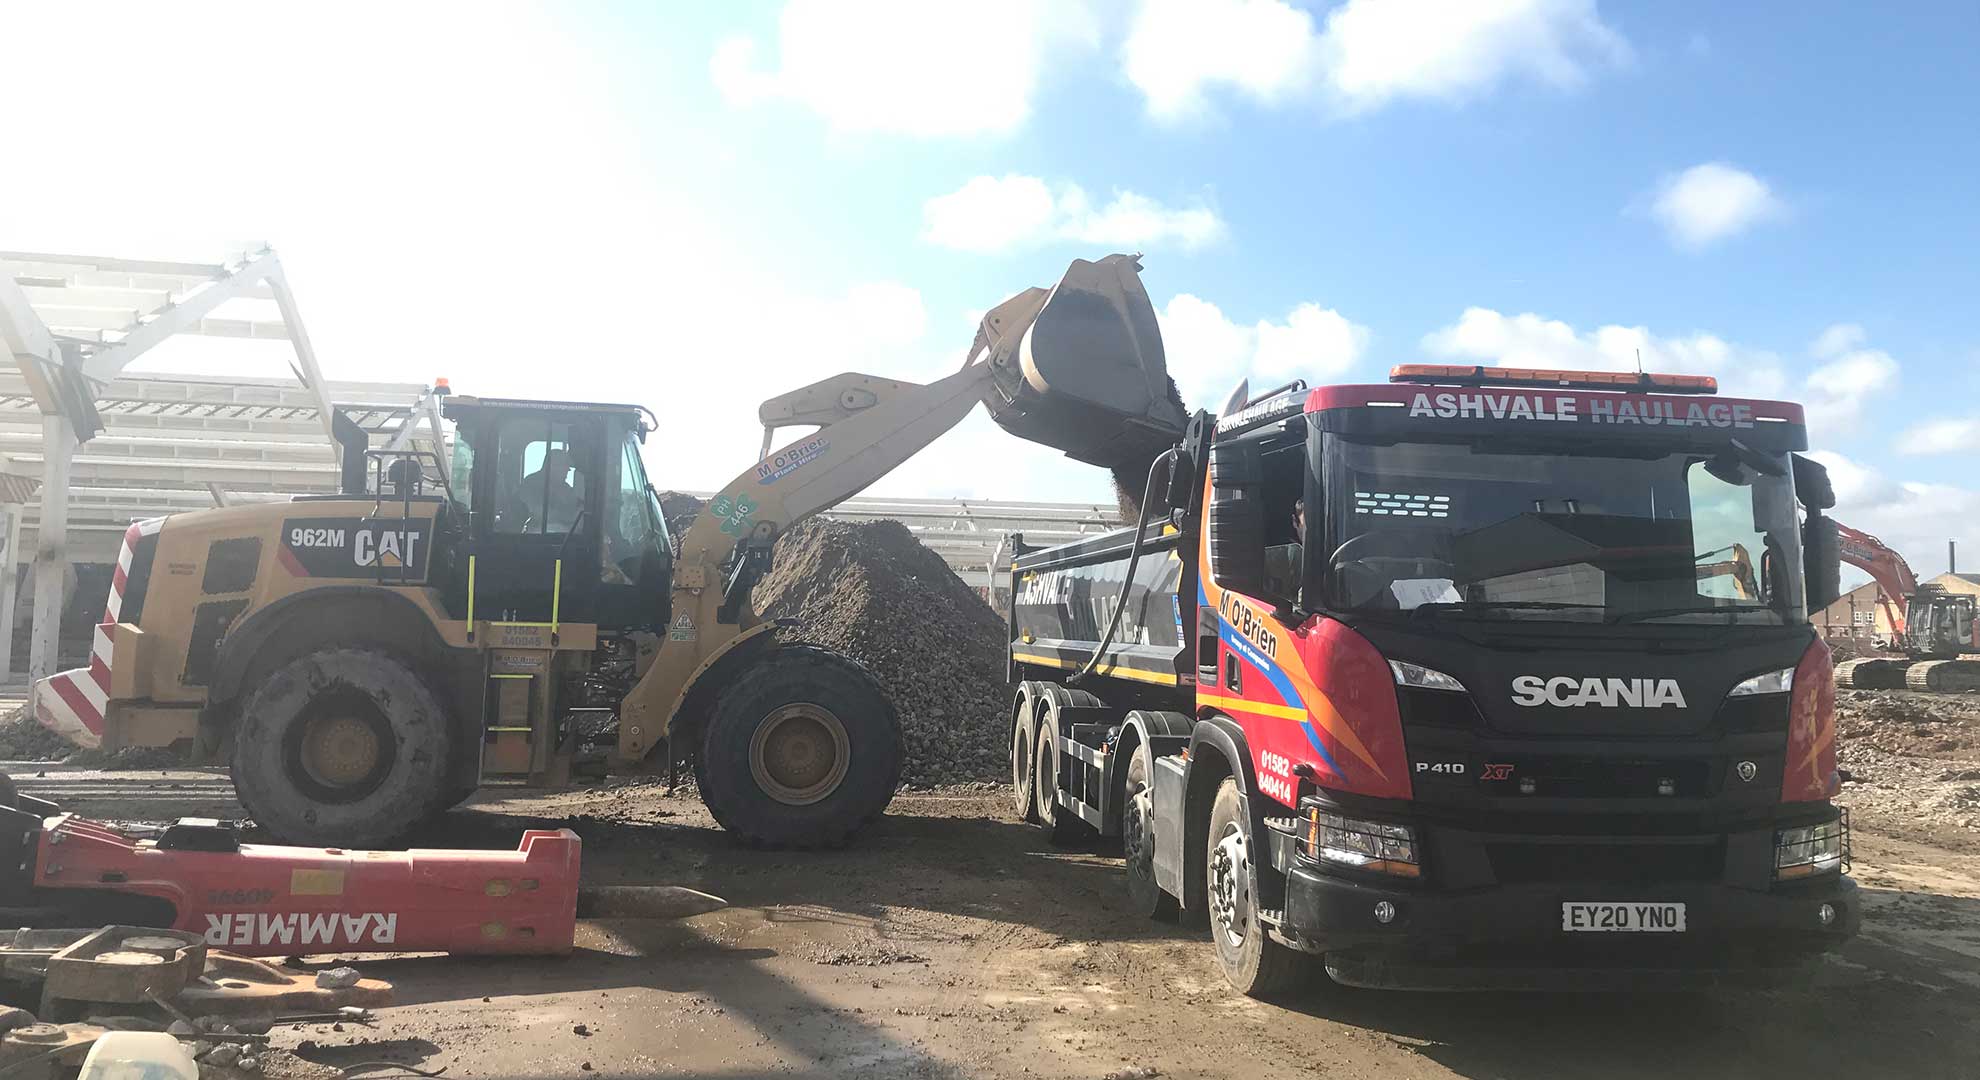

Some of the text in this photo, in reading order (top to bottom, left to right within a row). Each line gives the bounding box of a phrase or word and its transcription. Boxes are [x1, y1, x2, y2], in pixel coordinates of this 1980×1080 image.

[1409, 393, 1754, 428] ASHVALE HAULAGE
[757, 438, 827, 478] M O'Brien
[717, 499, 731, 515] PH
[731, 503, 749, 527] 446
[291, 527, 345, 548] 962M
[354, 529, 420, 568] CAT
[1220, 588, 1278, 660] M O'Brien
[1511, 675, 1688, 708] SCANIA
[1261, 749, 1290, 778] 01582
[1416, 762, 1465, 774] P 410
[1480, 764, 1515, 781] XT
[1258, 771, 1292, 803] 840414
[205, 912, 398, 946] RAMMER
[1570, 905, 1677, 928] EY20 YNO
